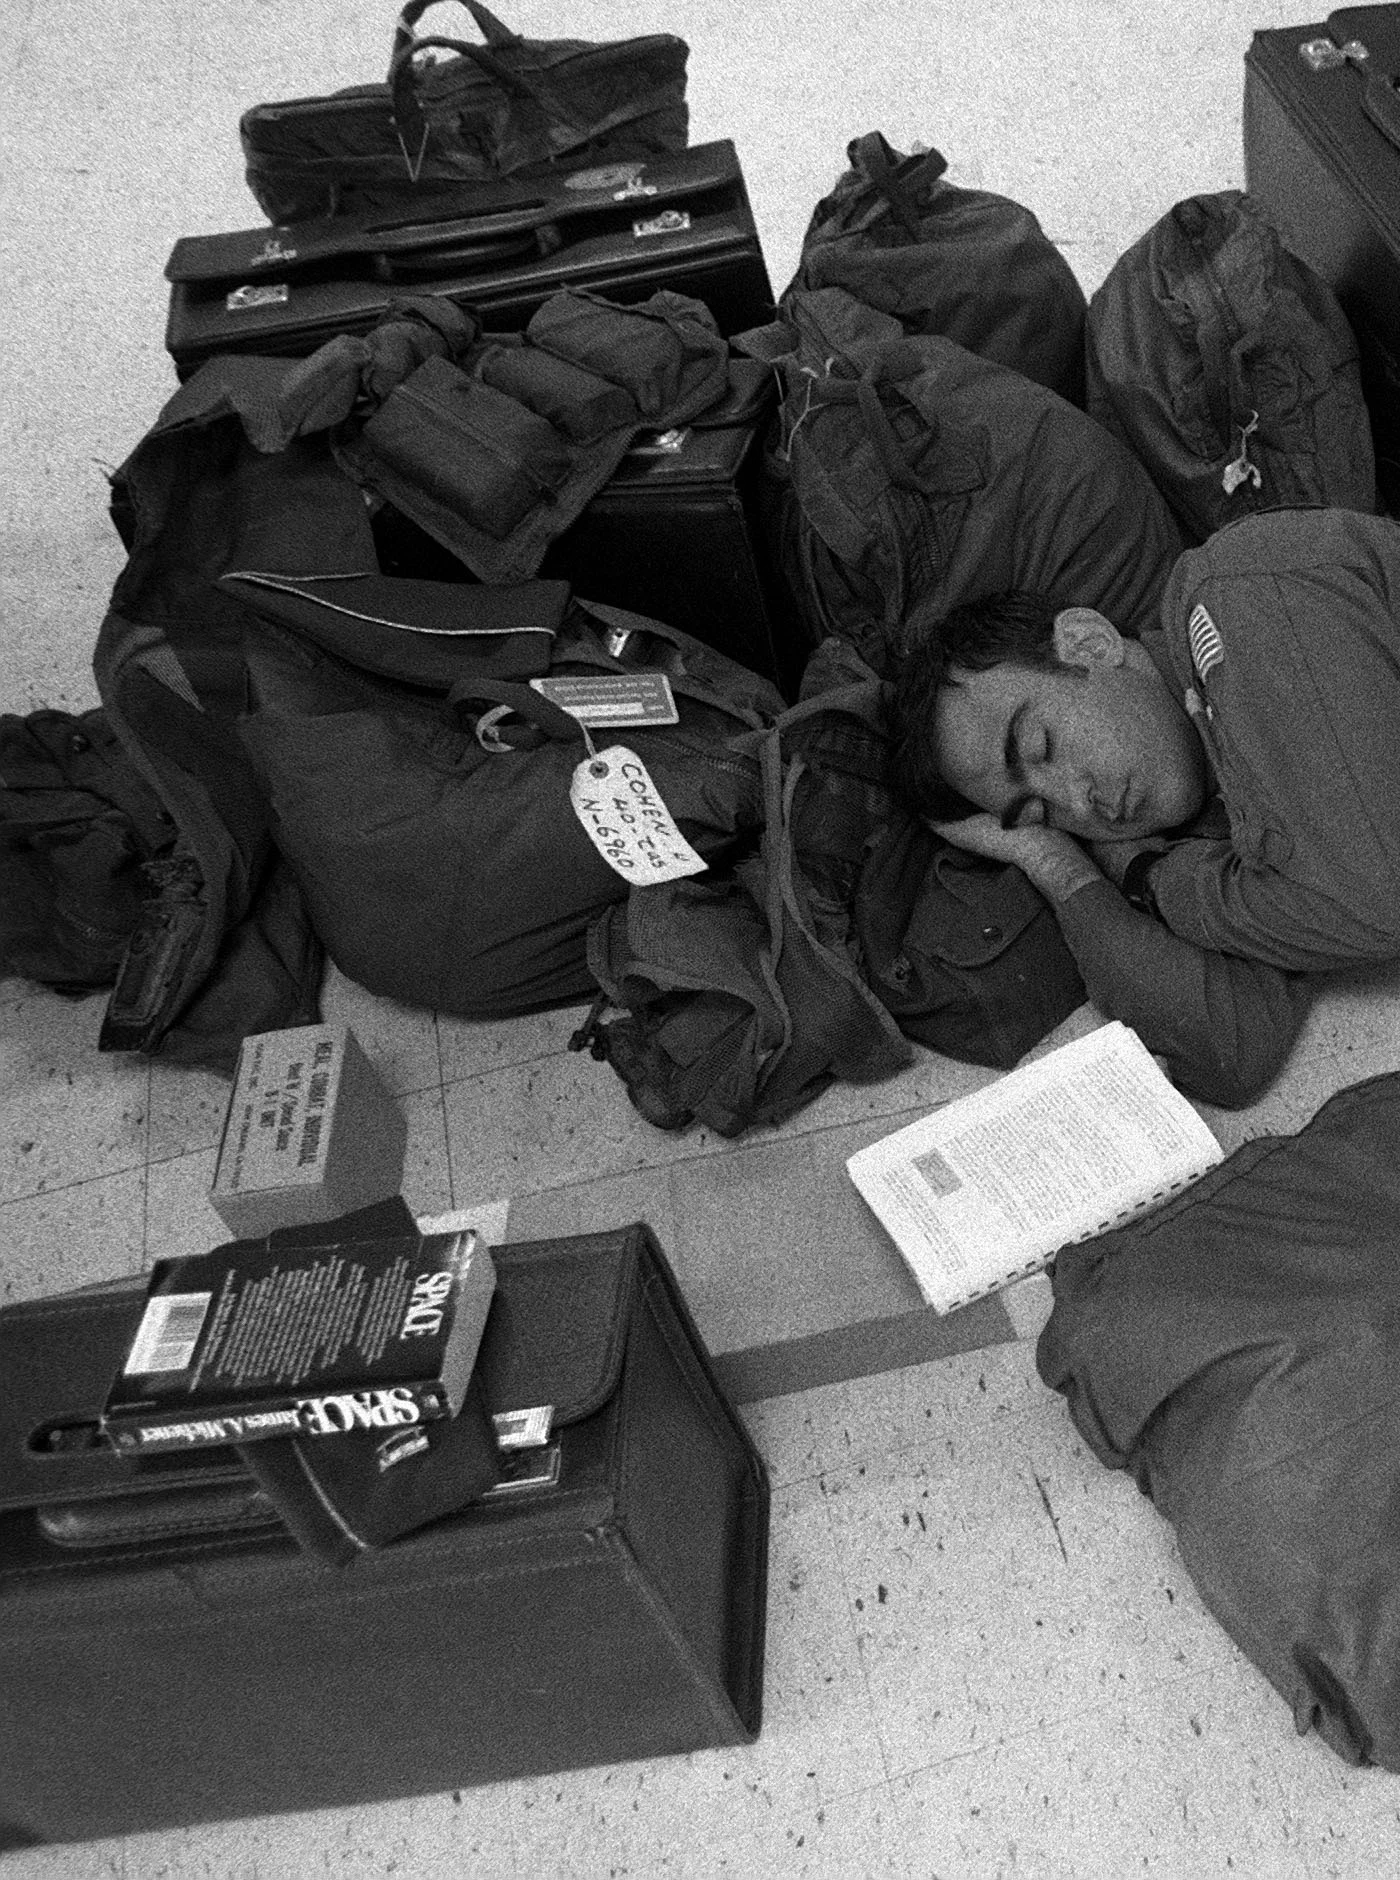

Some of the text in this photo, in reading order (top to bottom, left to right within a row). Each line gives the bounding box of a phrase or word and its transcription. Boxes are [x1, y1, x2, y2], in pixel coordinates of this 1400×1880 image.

[400, 1271, 453, 1340] SPACE
[244, 1409, 300, 1428] James
[297, 1387, 421, 1434] SPACE
